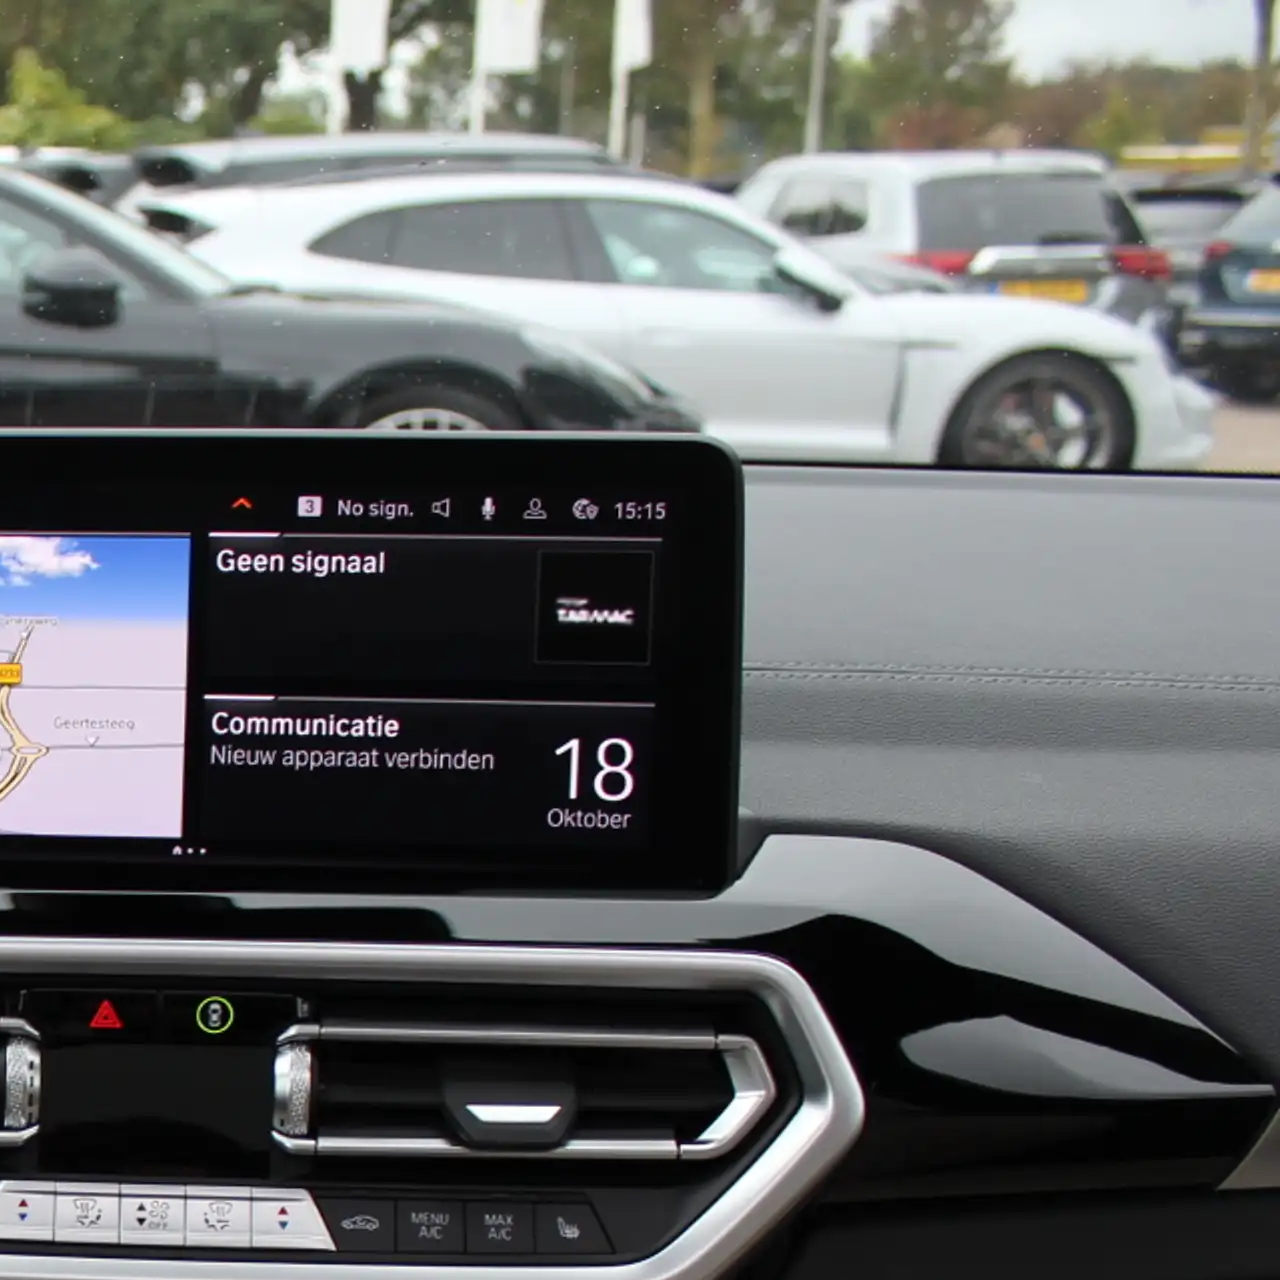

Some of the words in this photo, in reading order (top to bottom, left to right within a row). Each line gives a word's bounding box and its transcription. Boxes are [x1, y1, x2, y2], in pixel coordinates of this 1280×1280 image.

[338, 500, 363, 516] No
[368, 500, 414, 520] sign.
[614, 502, 666, 520] 15:15
[216, 550, 284, 573] Geen
[291, 551, 385, 577] signaal
[211, 711, 399, 738] Communicatie
[210, 745, 276, 767] Nieuw
[282, 747, 379, 771] apparaat
[385, 749, 494, 770] verbinden
[555, 739, 634, 801] 18
[548, 808, 630, 829] Oktober
[148, 1221, 169, 1230] OFF
[411, 1211, 449, 1225] MENU
[484, 1214, 513, 1226] MAX
[418, 1226, 444, 1240] A/C
[487, 1227, 513, 1242] A/C
